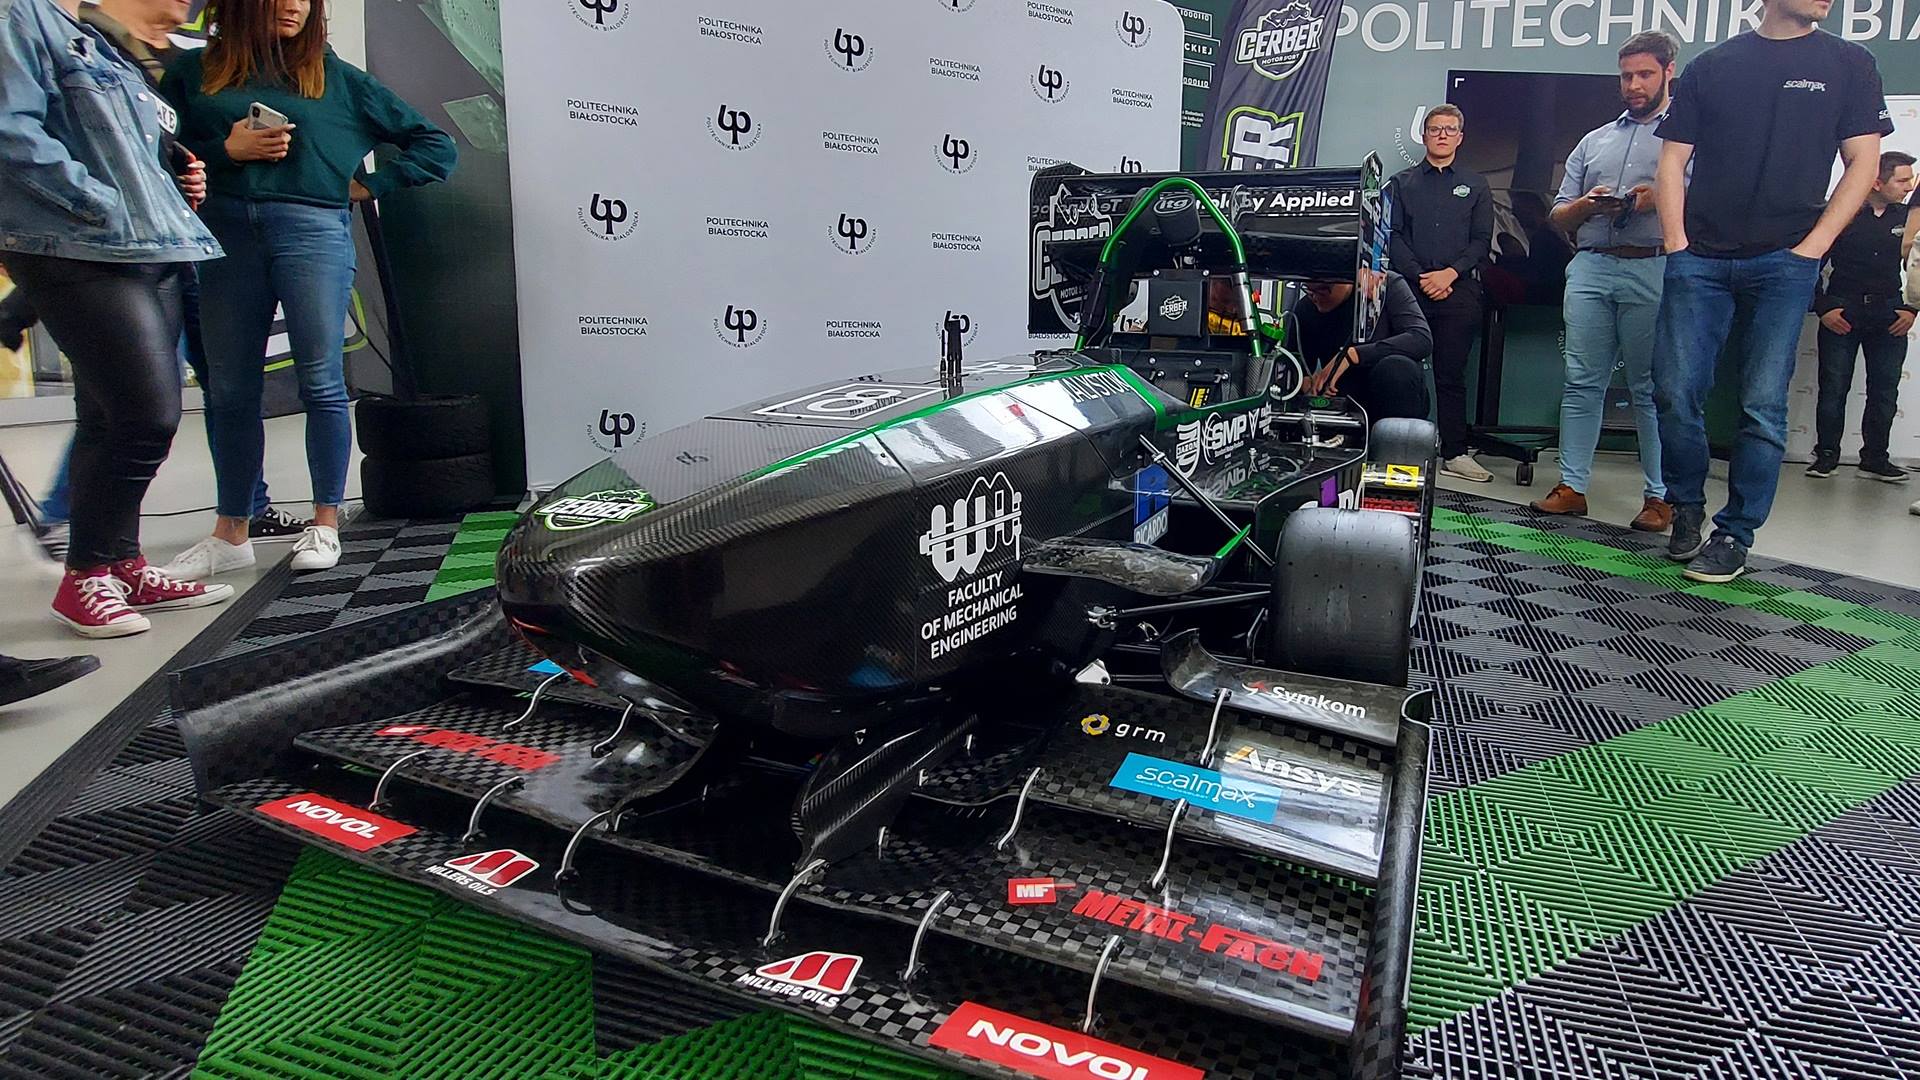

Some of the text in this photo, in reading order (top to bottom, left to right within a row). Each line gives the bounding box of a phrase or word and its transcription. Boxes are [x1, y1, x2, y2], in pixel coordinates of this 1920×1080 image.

[1027, 1, 1074, 17] POLITECHNIKA
[1028, 10, 1073, 26] BIAŁOSTOCKA
[698, 16, 763, 35] POLITECHNIKA
[1336, 0, 1920, 52] POLITECHNIK BI
[700, 26, 762, 46] BIAŁOSTOCKA
[929, 57, 981, 73] POLITECHNIKA
[931, 67, 980, 82] BIAŁOSTOCKA
[1111, 88, 1153, 101] POLITECHNIKA
[1783, 79, 1826, 92] scalmax
[567, 98, 639, 117] POLITECHNIKA
[569, 110, 638, 127] BIAŁOSTOCKA
[823, 131, 880, 146] POLITECHNIKA
[1395, 126, 1418, 168] POLITECHN
[824, 141, 879, 155] BIAŁOSTOCKA
[1270, 190, 1355, 211] Applied
[706, 216, 769, 229] POLITECHNIKA
[708, 226, 768, 239] BIAŁOSTOCKA
[931, 232, 982, 243] POLITECHNIKA
[933, 241, 981, 252] BIAŁOSTOCKA
[579, 315, 648, 327] POLITECHNIKA
[826, 320, 882, 330] POLITECHNIKA
[581, 326, 647, 337] BIAŁOSTOCKA
[827, 330, 881, 339] BIAŁOSTOCKA
[1211, 414, 1247, 451] SMP
[1135, 511, 1168, 544] RICARDO
[948, 571, 1003, 608] FACULTY
[921, 583, 1024, 641] OF MECHANICAL
[930, 605, 1017, 660] ENGINEERING
[1272, 686, 1366, 719] Symkom
[1114, 719, 1166, 743] grm
[1224, 745, 1363, 798] Ansys
[1135, 764, 1257, 809] scalmax
[285, 799, 382, 840] NOVOL
[426, 864, 497, 897] MILLERS OILS
[1016, 884, 1049, 899] MF
[737, 972, 840, 1009] MILLERS OILS
